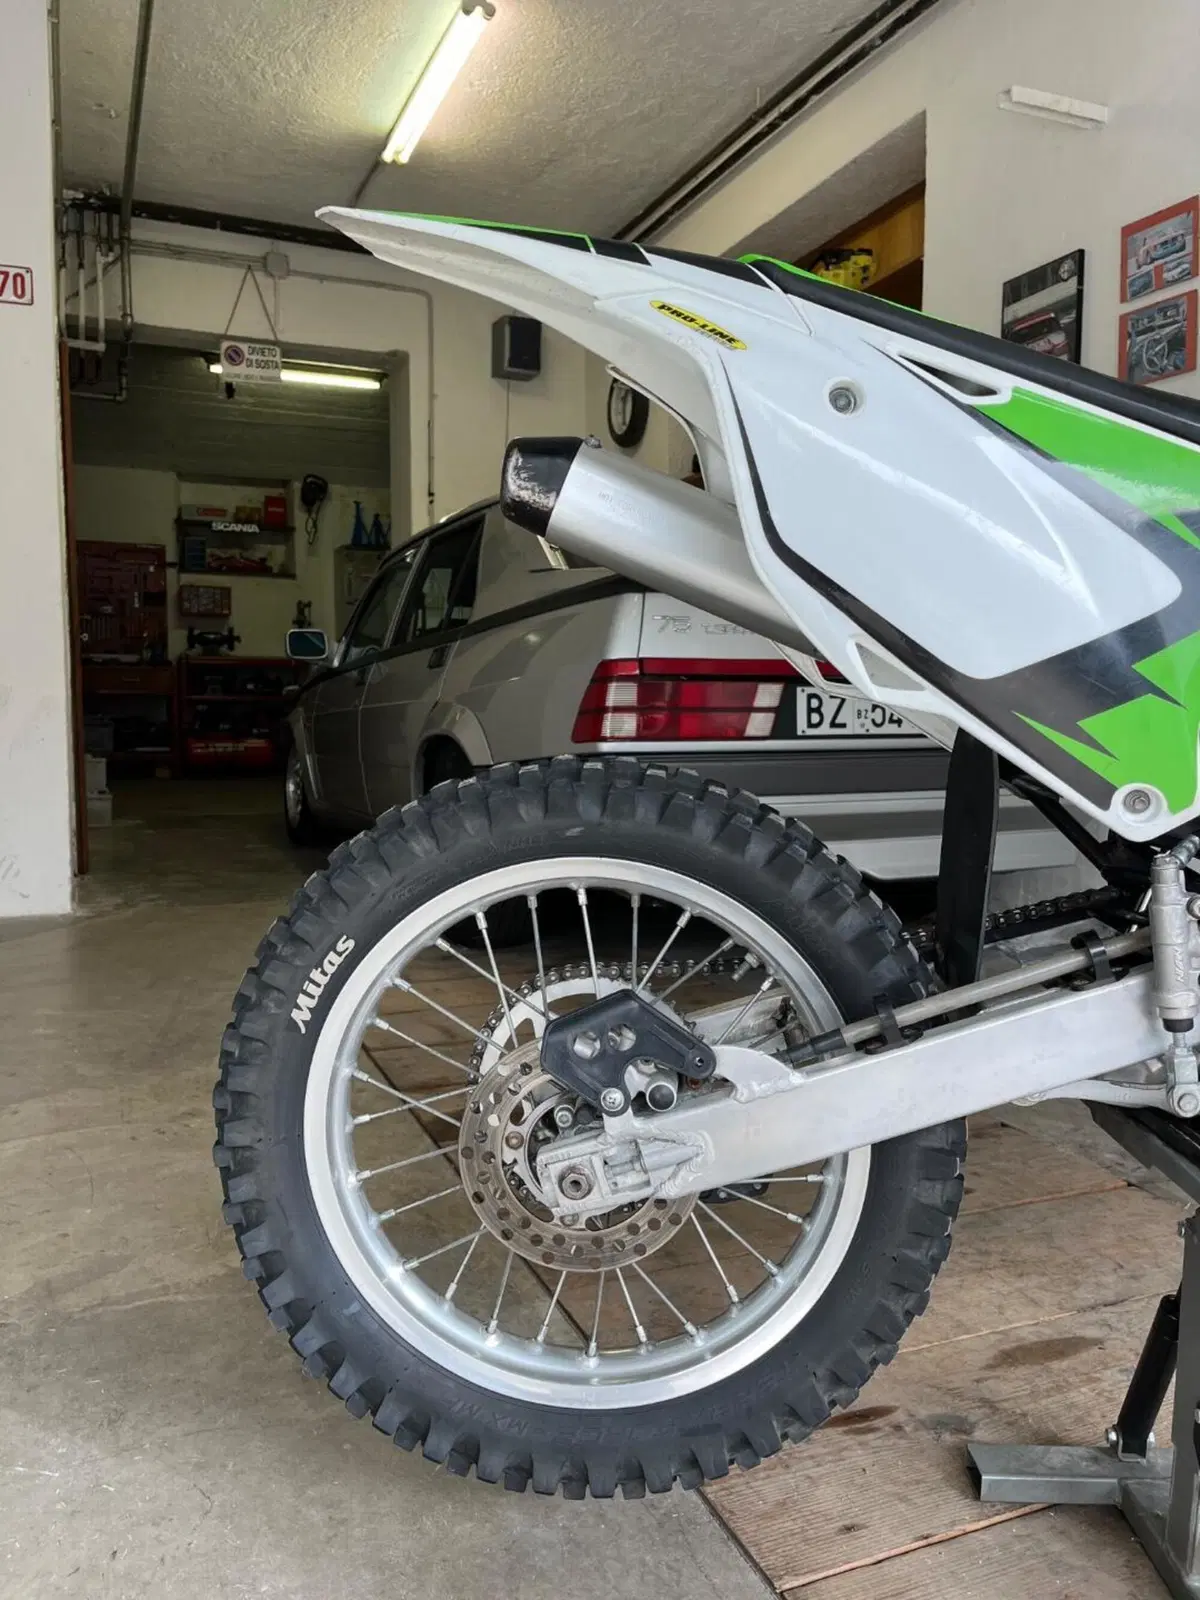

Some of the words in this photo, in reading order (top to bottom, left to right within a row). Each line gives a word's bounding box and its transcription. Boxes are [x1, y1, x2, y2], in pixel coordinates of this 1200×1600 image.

[657, 303, 740, 345] PRO-LINE
[247, 345, 277, 358] DIVIETO
[245, 357, 254, 369] DI
[255, 358, 280, 370] SOSTA
[211, 521, 260, 534] SCANIA
[652, 614, 692, 635] 75
[806, 692, 847, 729] BZ
[290, 934, 355, 1035] Mitas
